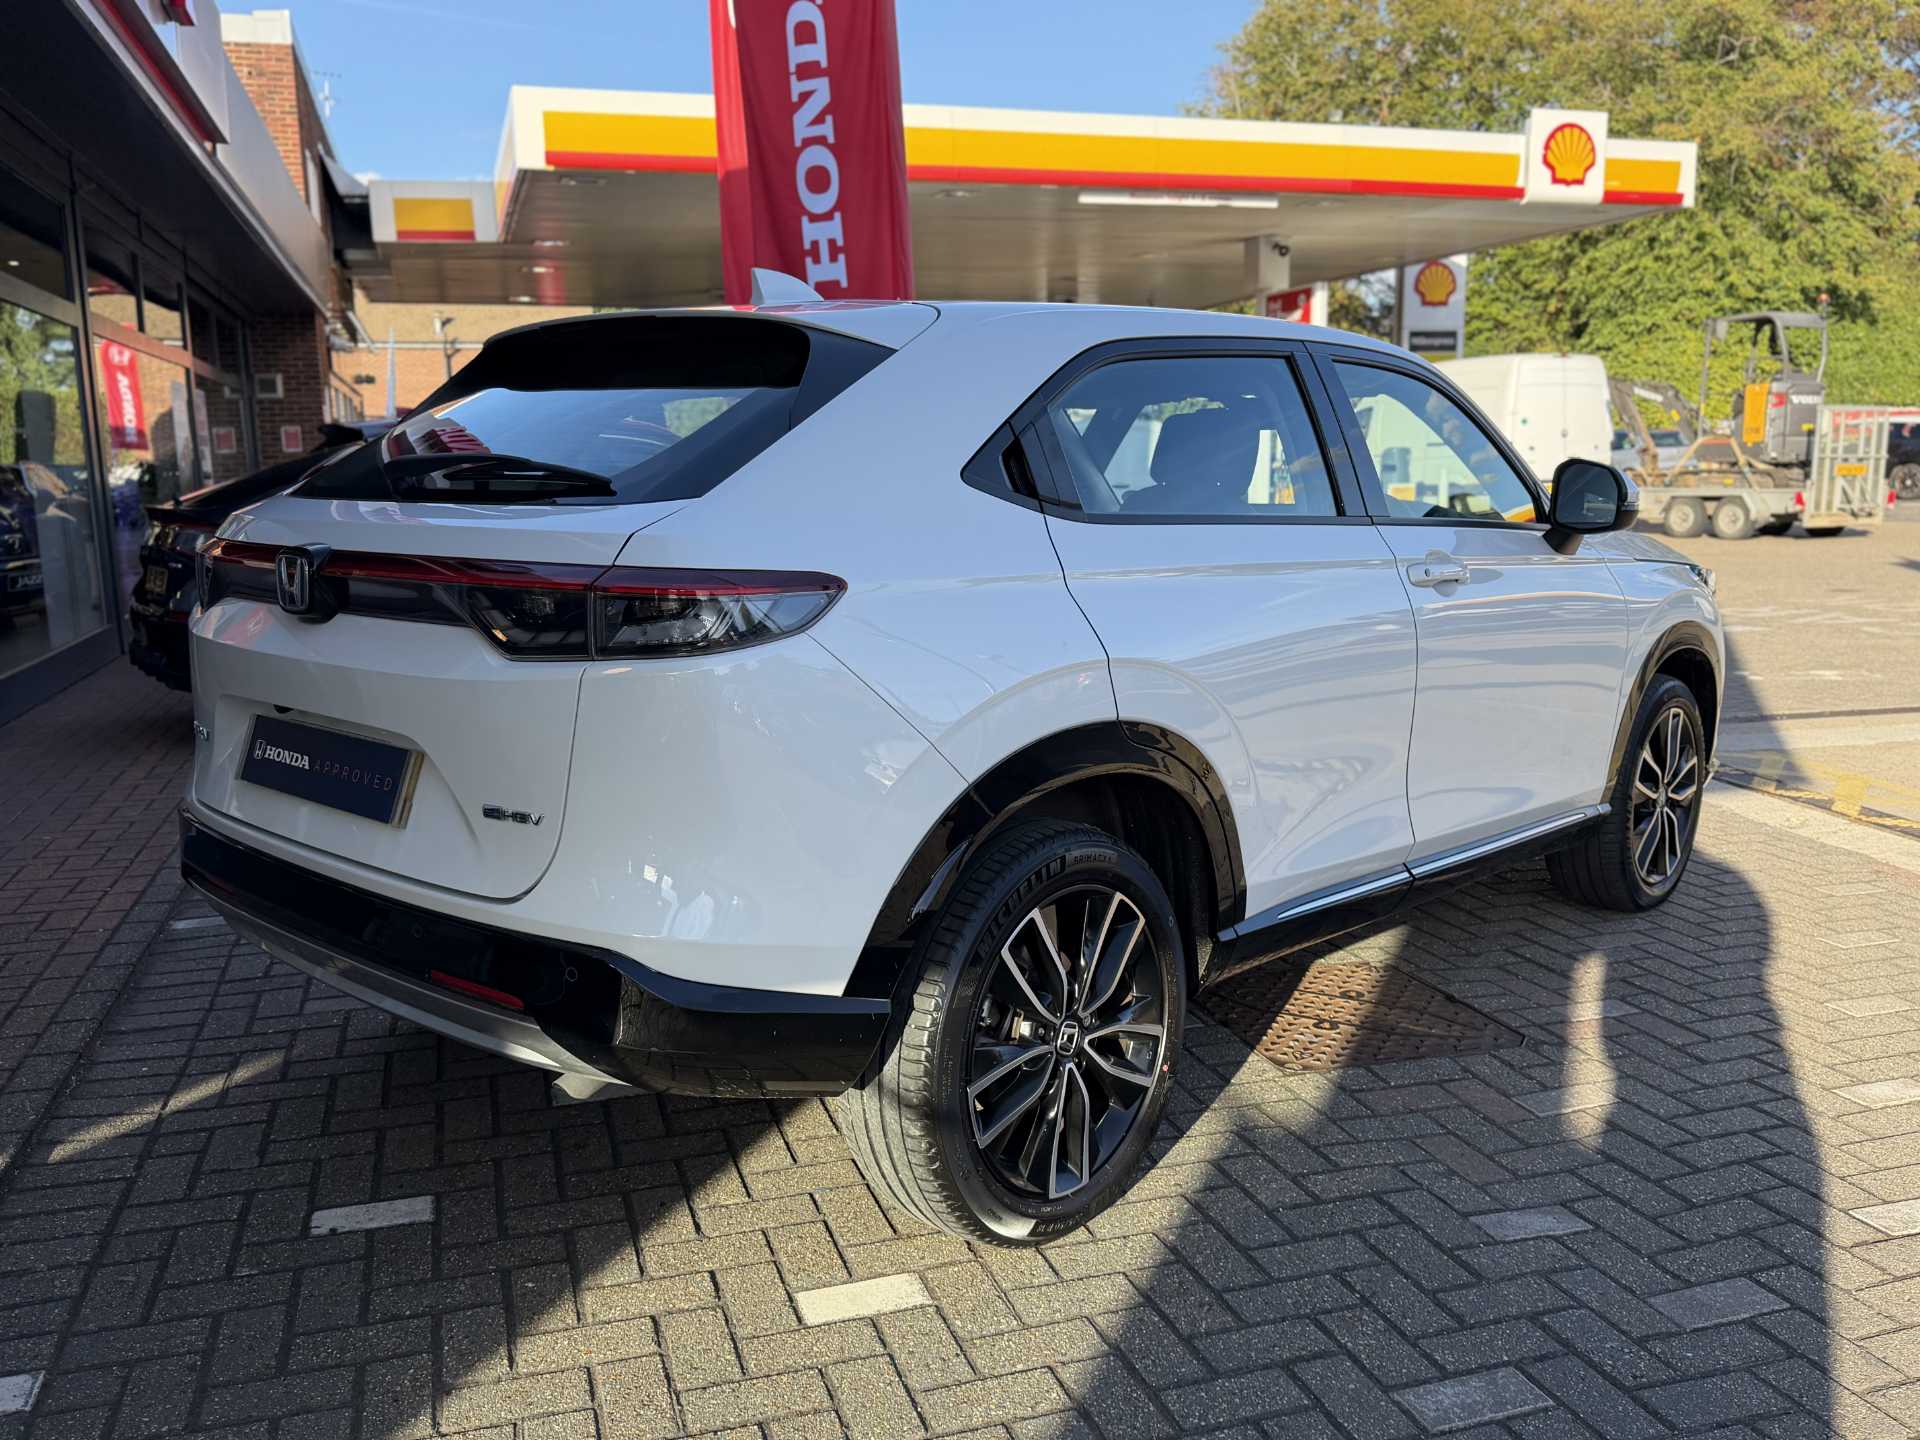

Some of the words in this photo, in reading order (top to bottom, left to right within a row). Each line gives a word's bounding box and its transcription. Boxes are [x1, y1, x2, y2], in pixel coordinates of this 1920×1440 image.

[785, 0, 848, 290] HOND
[264, 745, 310, 770] HONDA
[313, 760, 393, 790] APPROVED
